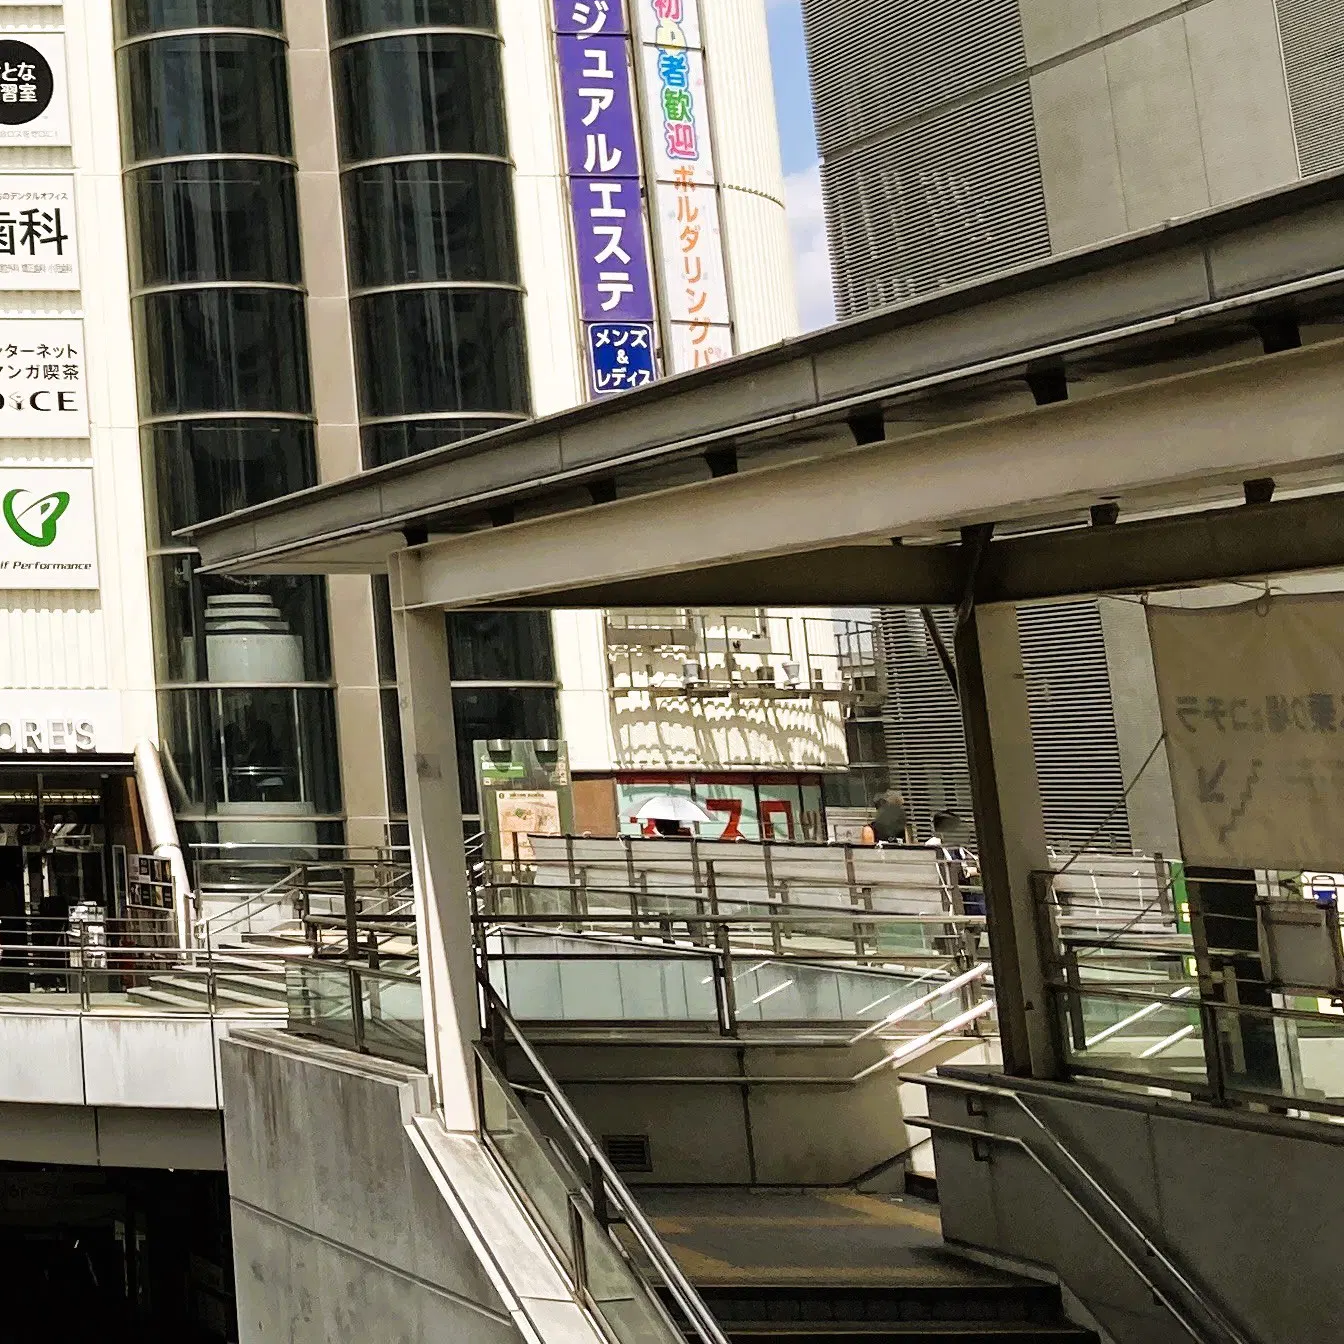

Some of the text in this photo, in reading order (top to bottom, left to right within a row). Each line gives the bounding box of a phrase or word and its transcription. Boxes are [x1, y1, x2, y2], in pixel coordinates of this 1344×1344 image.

[595, 329, 648, 349] メンズ
[616, 349, 629, 365] &
[597, 367, 651, 388] レディス
[13, 560, 92, 570] Performance
